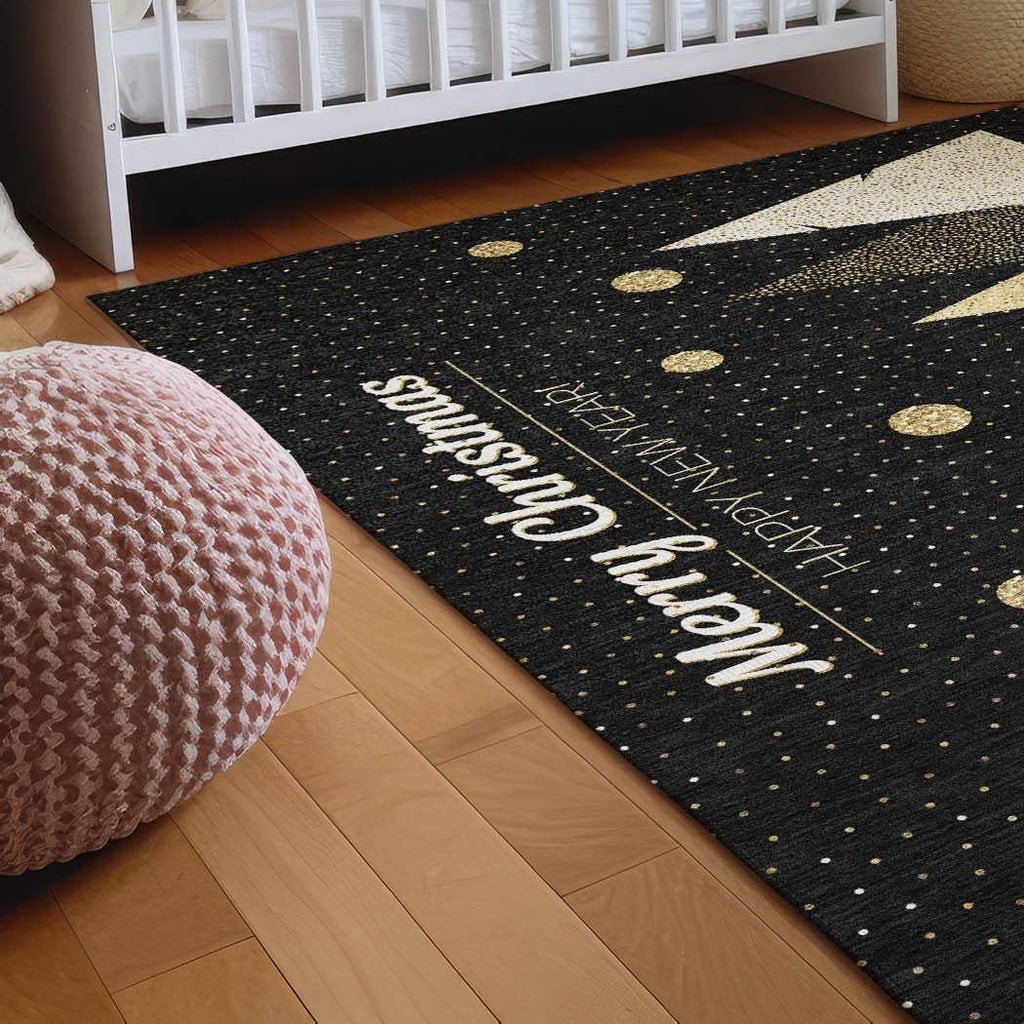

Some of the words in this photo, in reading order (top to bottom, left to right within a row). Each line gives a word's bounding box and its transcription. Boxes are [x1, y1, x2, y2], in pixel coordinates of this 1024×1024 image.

[362, 373, 617, 542] Christmas
[622, 436, 738, 494] NEW
[706, 490, 870, 578] HAPPY
[590, 534, 834, 687] Merry
